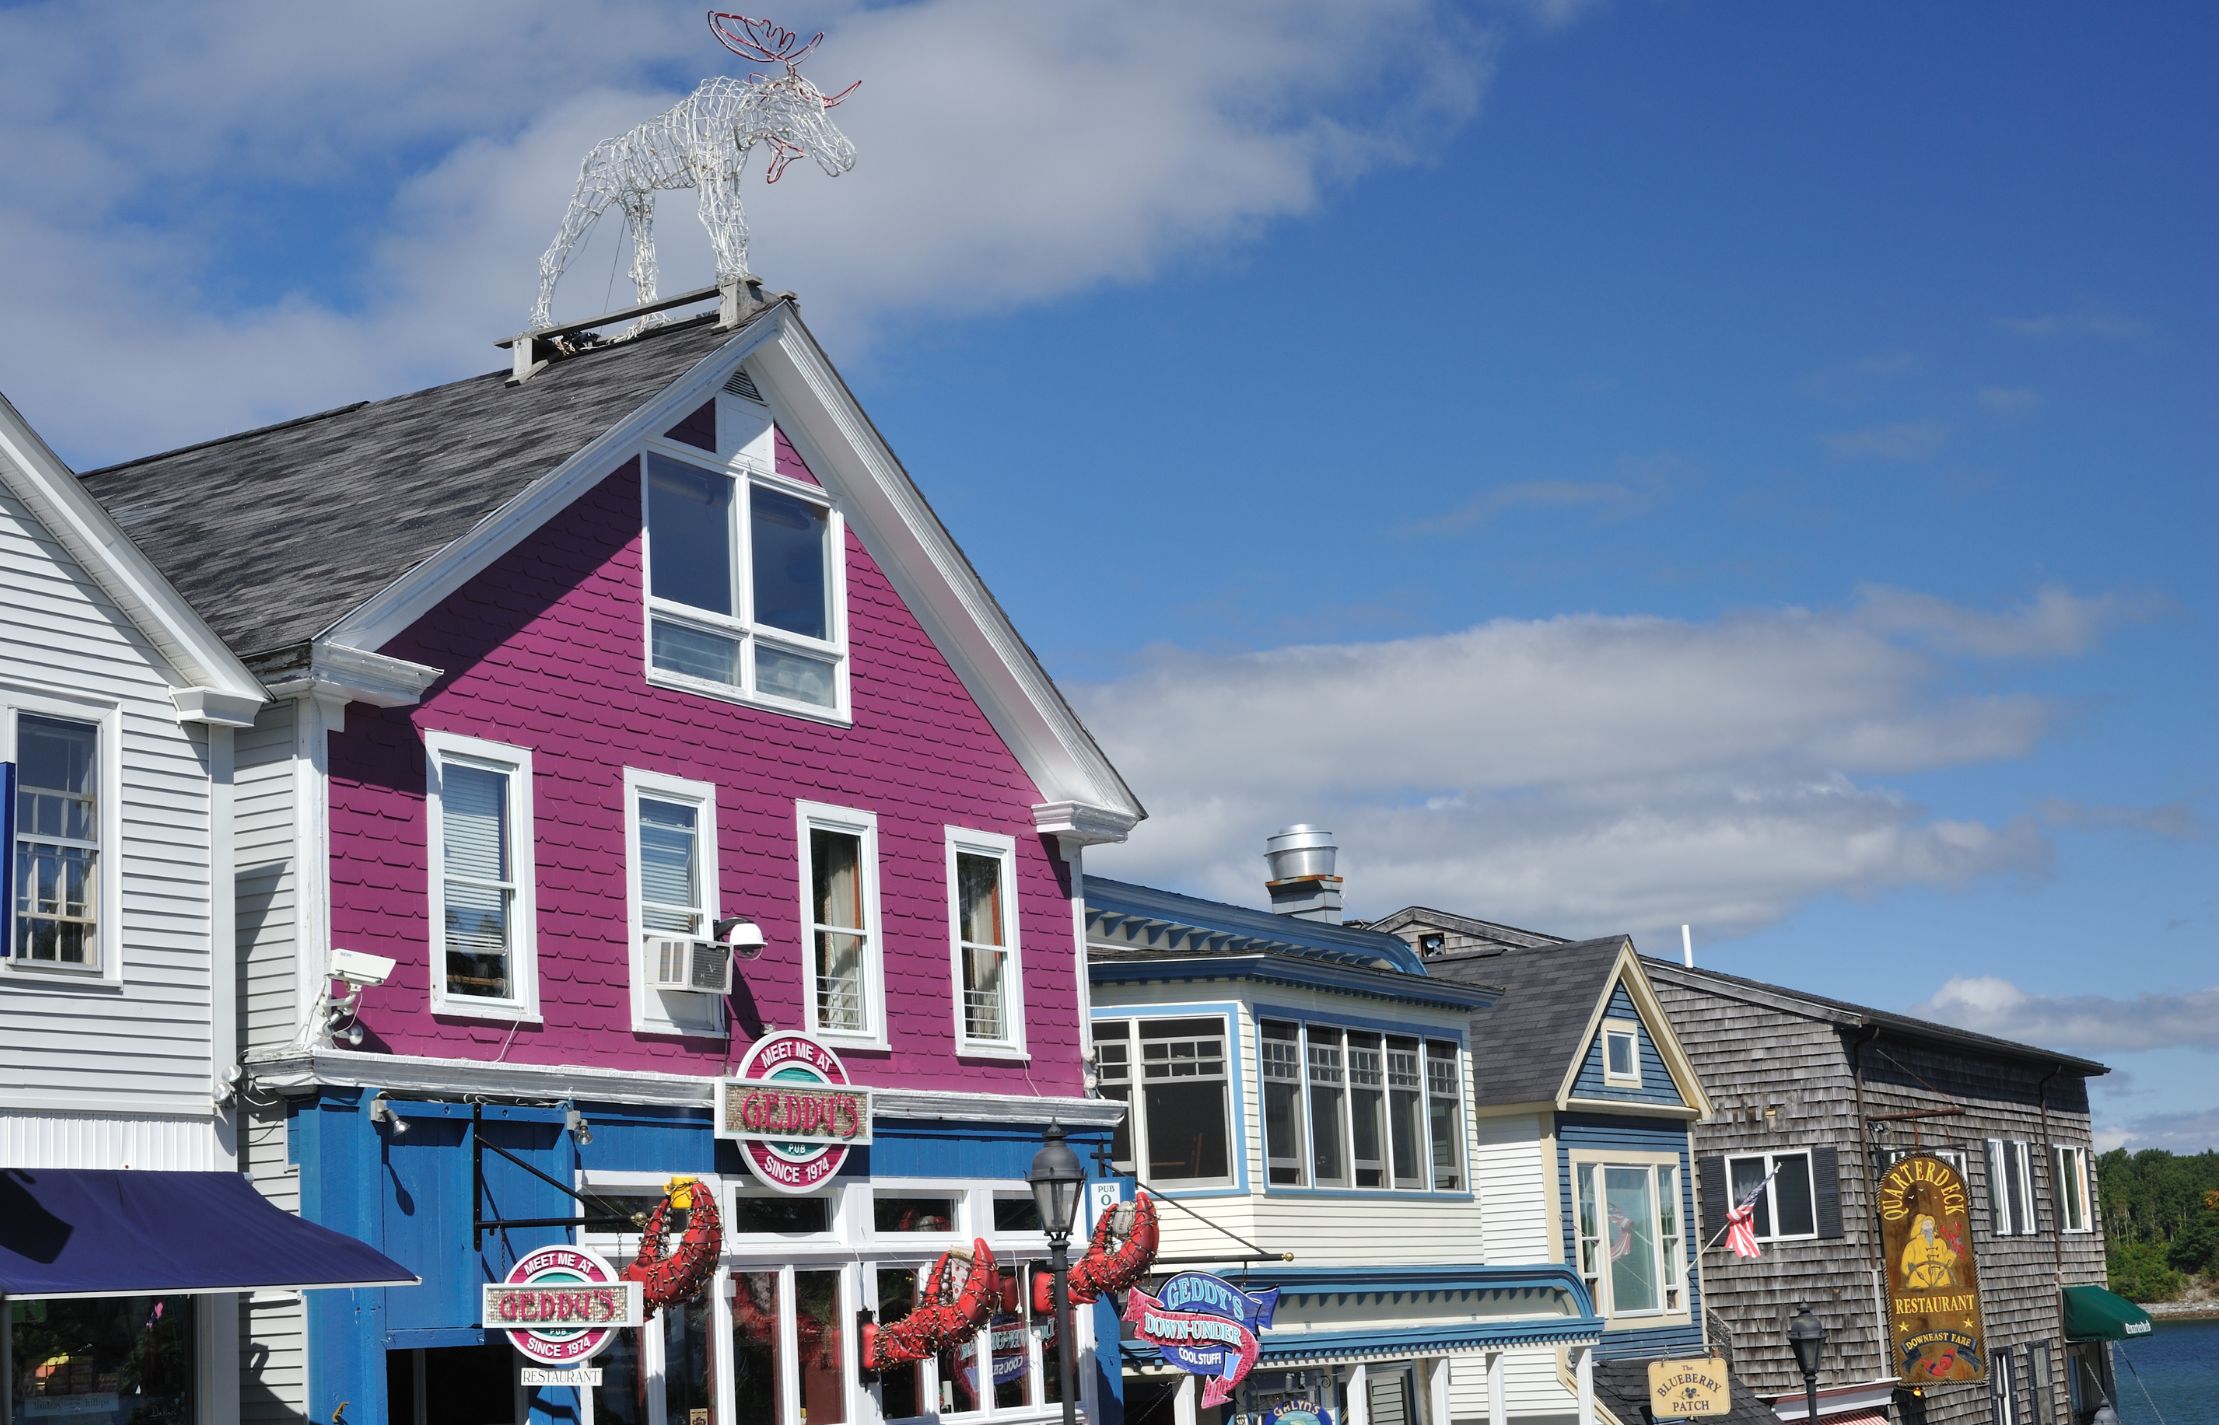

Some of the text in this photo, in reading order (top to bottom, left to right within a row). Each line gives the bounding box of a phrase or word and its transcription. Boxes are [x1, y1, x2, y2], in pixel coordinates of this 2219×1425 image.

[761, 1041, 833, 1073] MEET ME AT
[742, 1091, 858, 1136] GEDDY'S
[788, 1143, 806, 1154] PUB
[764, 1156, 830, 1183] SINCE 1974
[1097, 1184, 1115, 1193] PUB
[1882, 1160, 1966, 1221] QUARTERDECK
[524, 1252, 595, 1276] MEET ME AT
[500, 1289, 615, 1322] GEDDY'S
[1166, 1277, 1245, 1321] GEDDY'S
[1895, 1294, 1975, 1315] RESTAURANT
[1144, 1312, 1242, 1347] DOWN-UNDER
[1905, 1332, 1972, 1350] DOWNEAST FARE
[527, 1337, 591, 1357] SINCE 1974
[1178, 1347, 1222, 1365] COOL STUFF!
[523, 1370, 600, 1383] RESTAURANT
[1656, 1373, 1722, 1398] BLUEBERRY
[1672, 1400, 1710, 1412] PATCH
